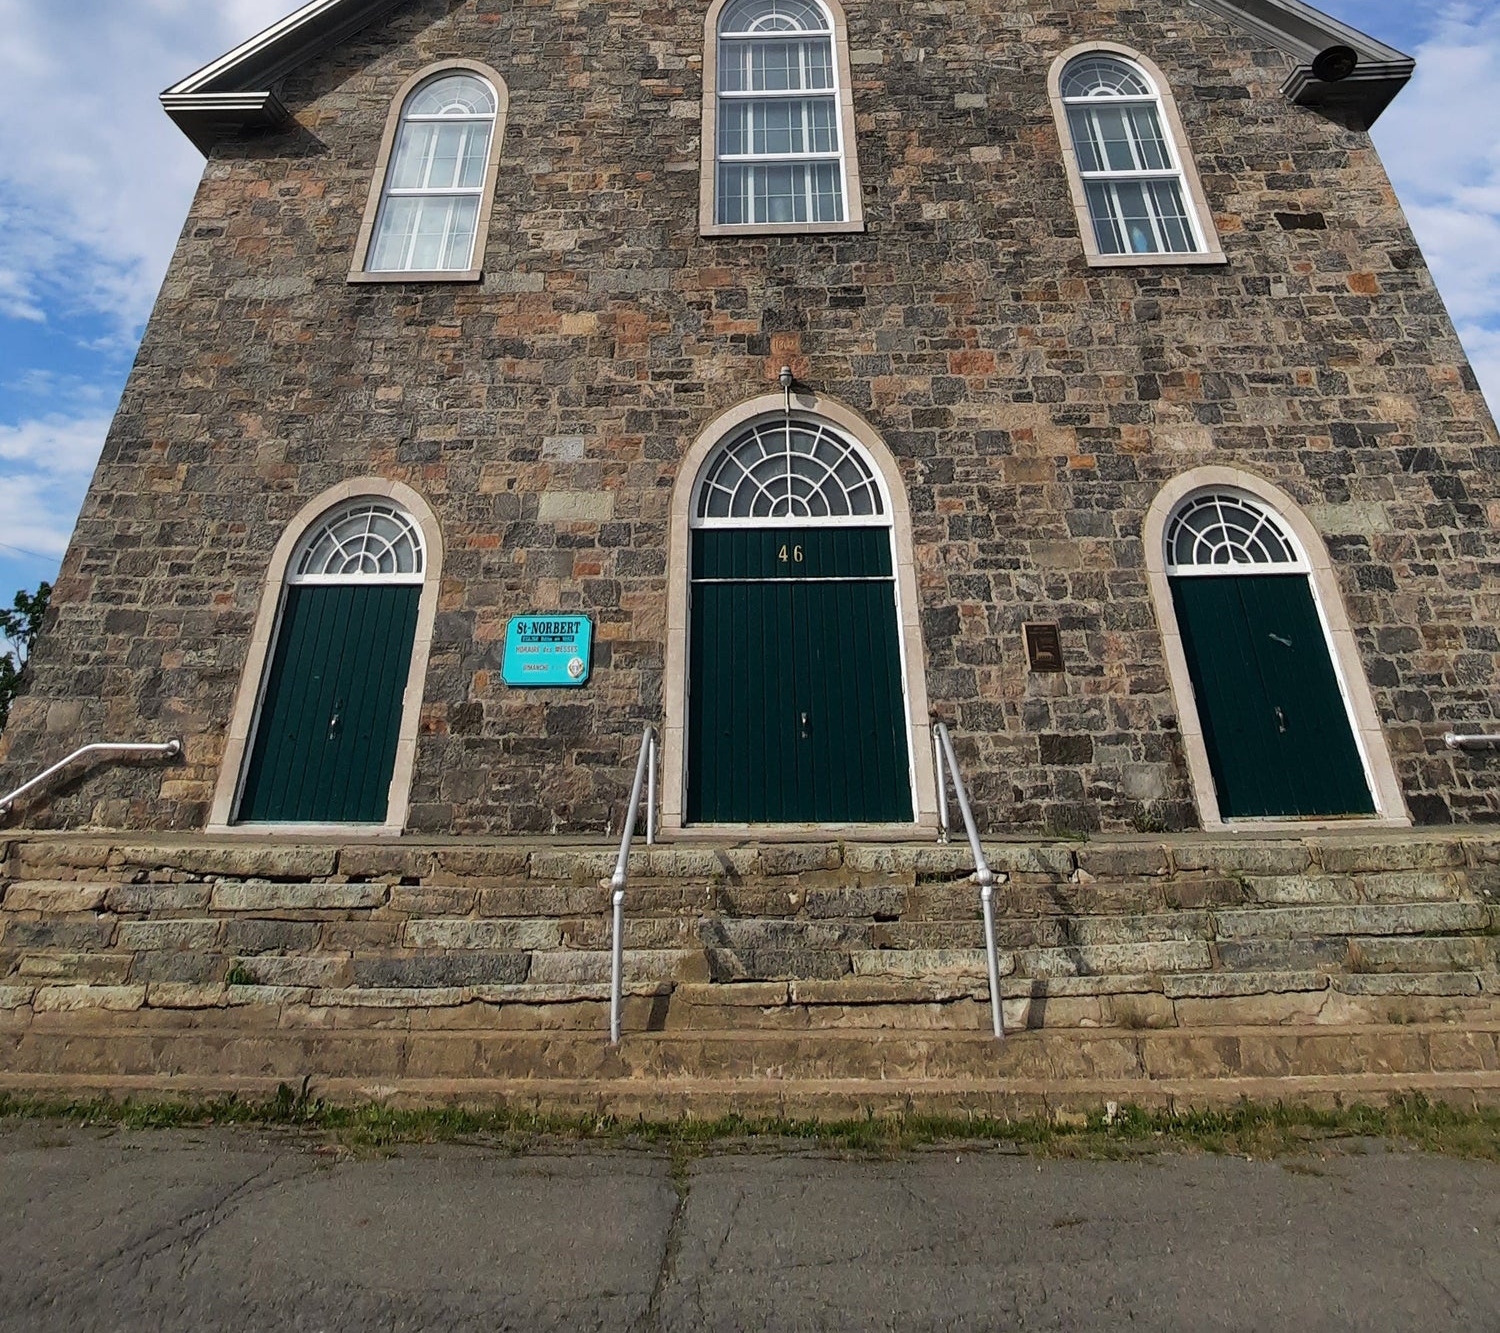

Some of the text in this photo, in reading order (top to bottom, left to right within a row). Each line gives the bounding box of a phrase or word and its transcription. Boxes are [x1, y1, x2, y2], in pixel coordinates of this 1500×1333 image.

[778, 544, 803, 563] 46
[517, 621, 580, 634] St-NORBERT
[555, 645, 578, 653] MESSES
